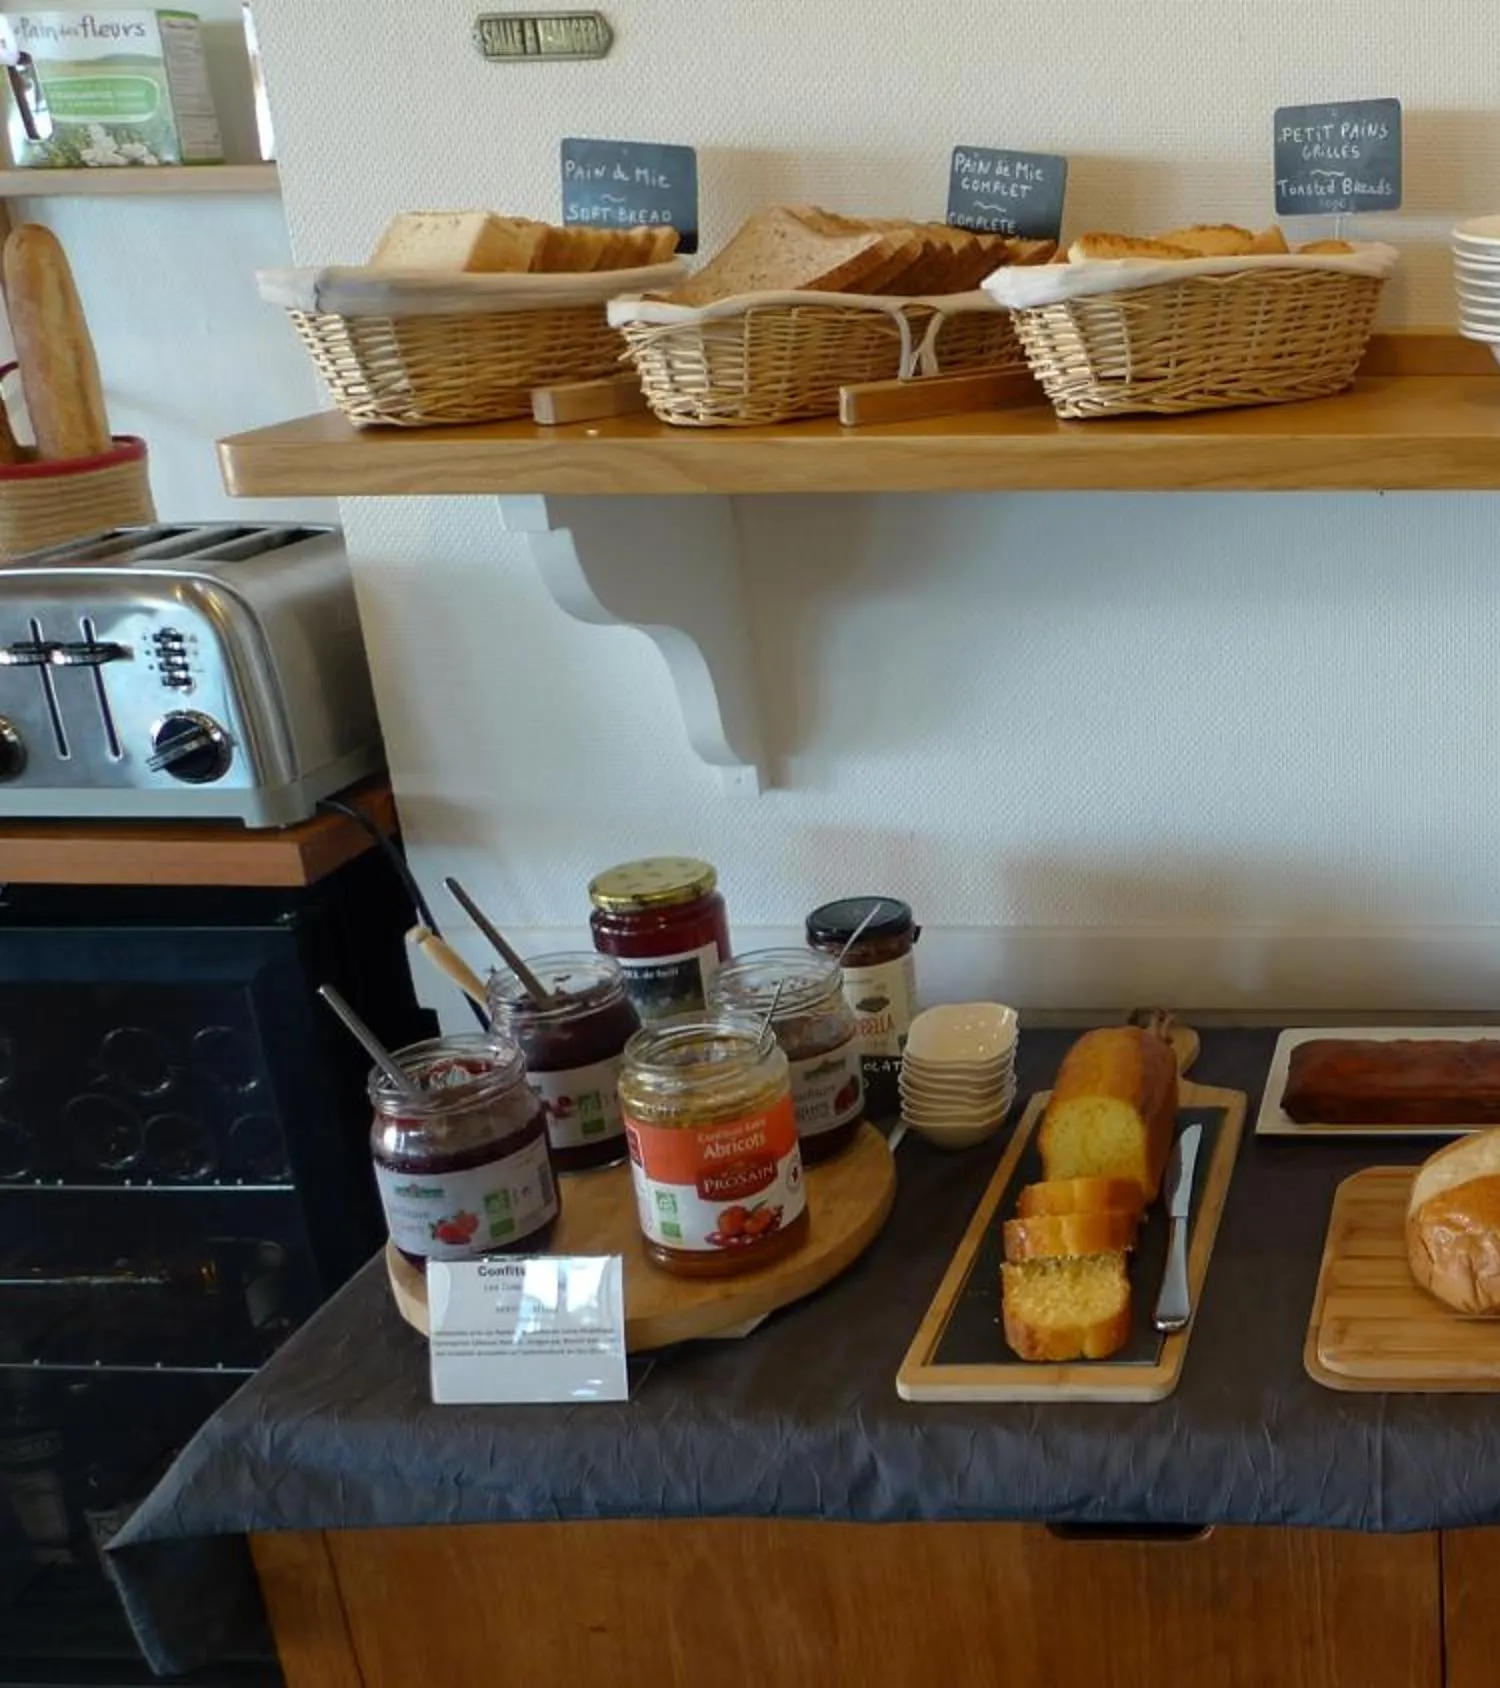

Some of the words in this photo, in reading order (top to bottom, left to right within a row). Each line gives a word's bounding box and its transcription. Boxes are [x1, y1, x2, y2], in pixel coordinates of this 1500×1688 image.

[80, 14, 146, 39] fleurs
[960, 177, 1034, 199] COMPLET
[566, 203, 611, 222] SOFT
[618, 207, 673, 225] BREAD
